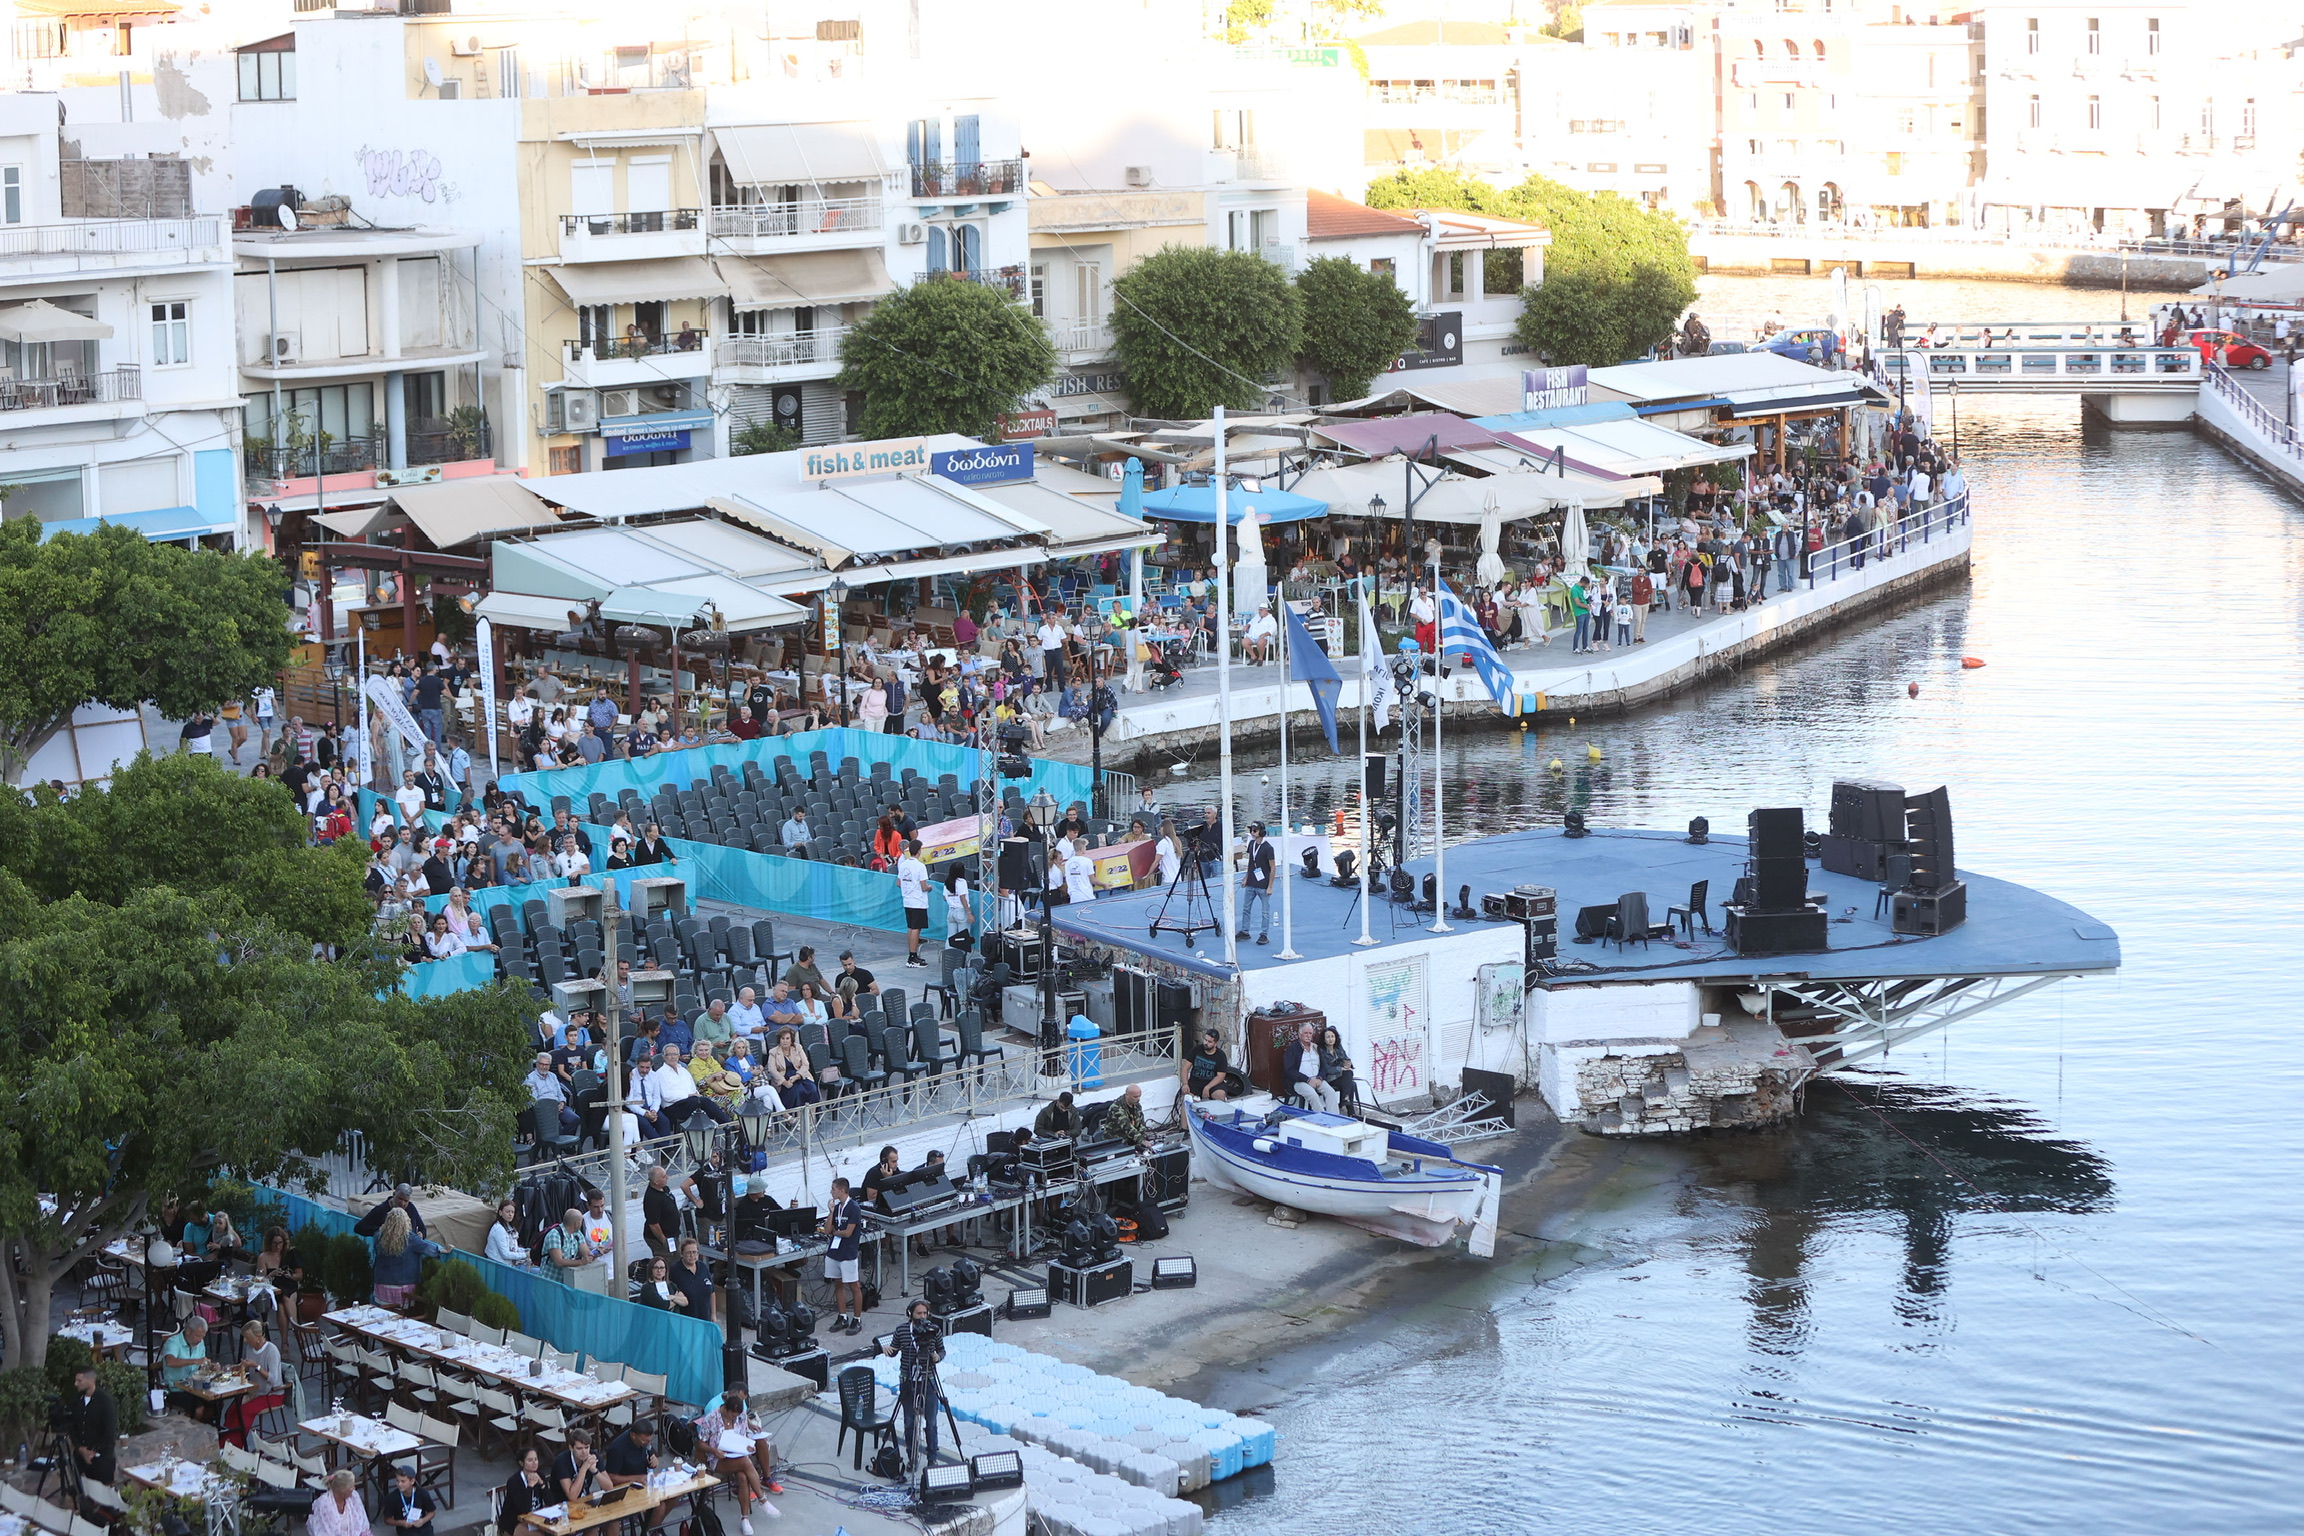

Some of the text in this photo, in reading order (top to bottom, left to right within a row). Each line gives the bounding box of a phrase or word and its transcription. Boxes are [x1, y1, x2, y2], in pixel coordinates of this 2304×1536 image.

[1055, 376, 1087, 394] FISH
[1545, 368, 1568, 389] FISH
[1526, 385, 1587, 411] RESTAURANT
[1007, 416, 1053, 433] COCKTAILS
[807, 444, 925, 475] fish & meat
[947, 451, 1020, 473] δωδώνη
